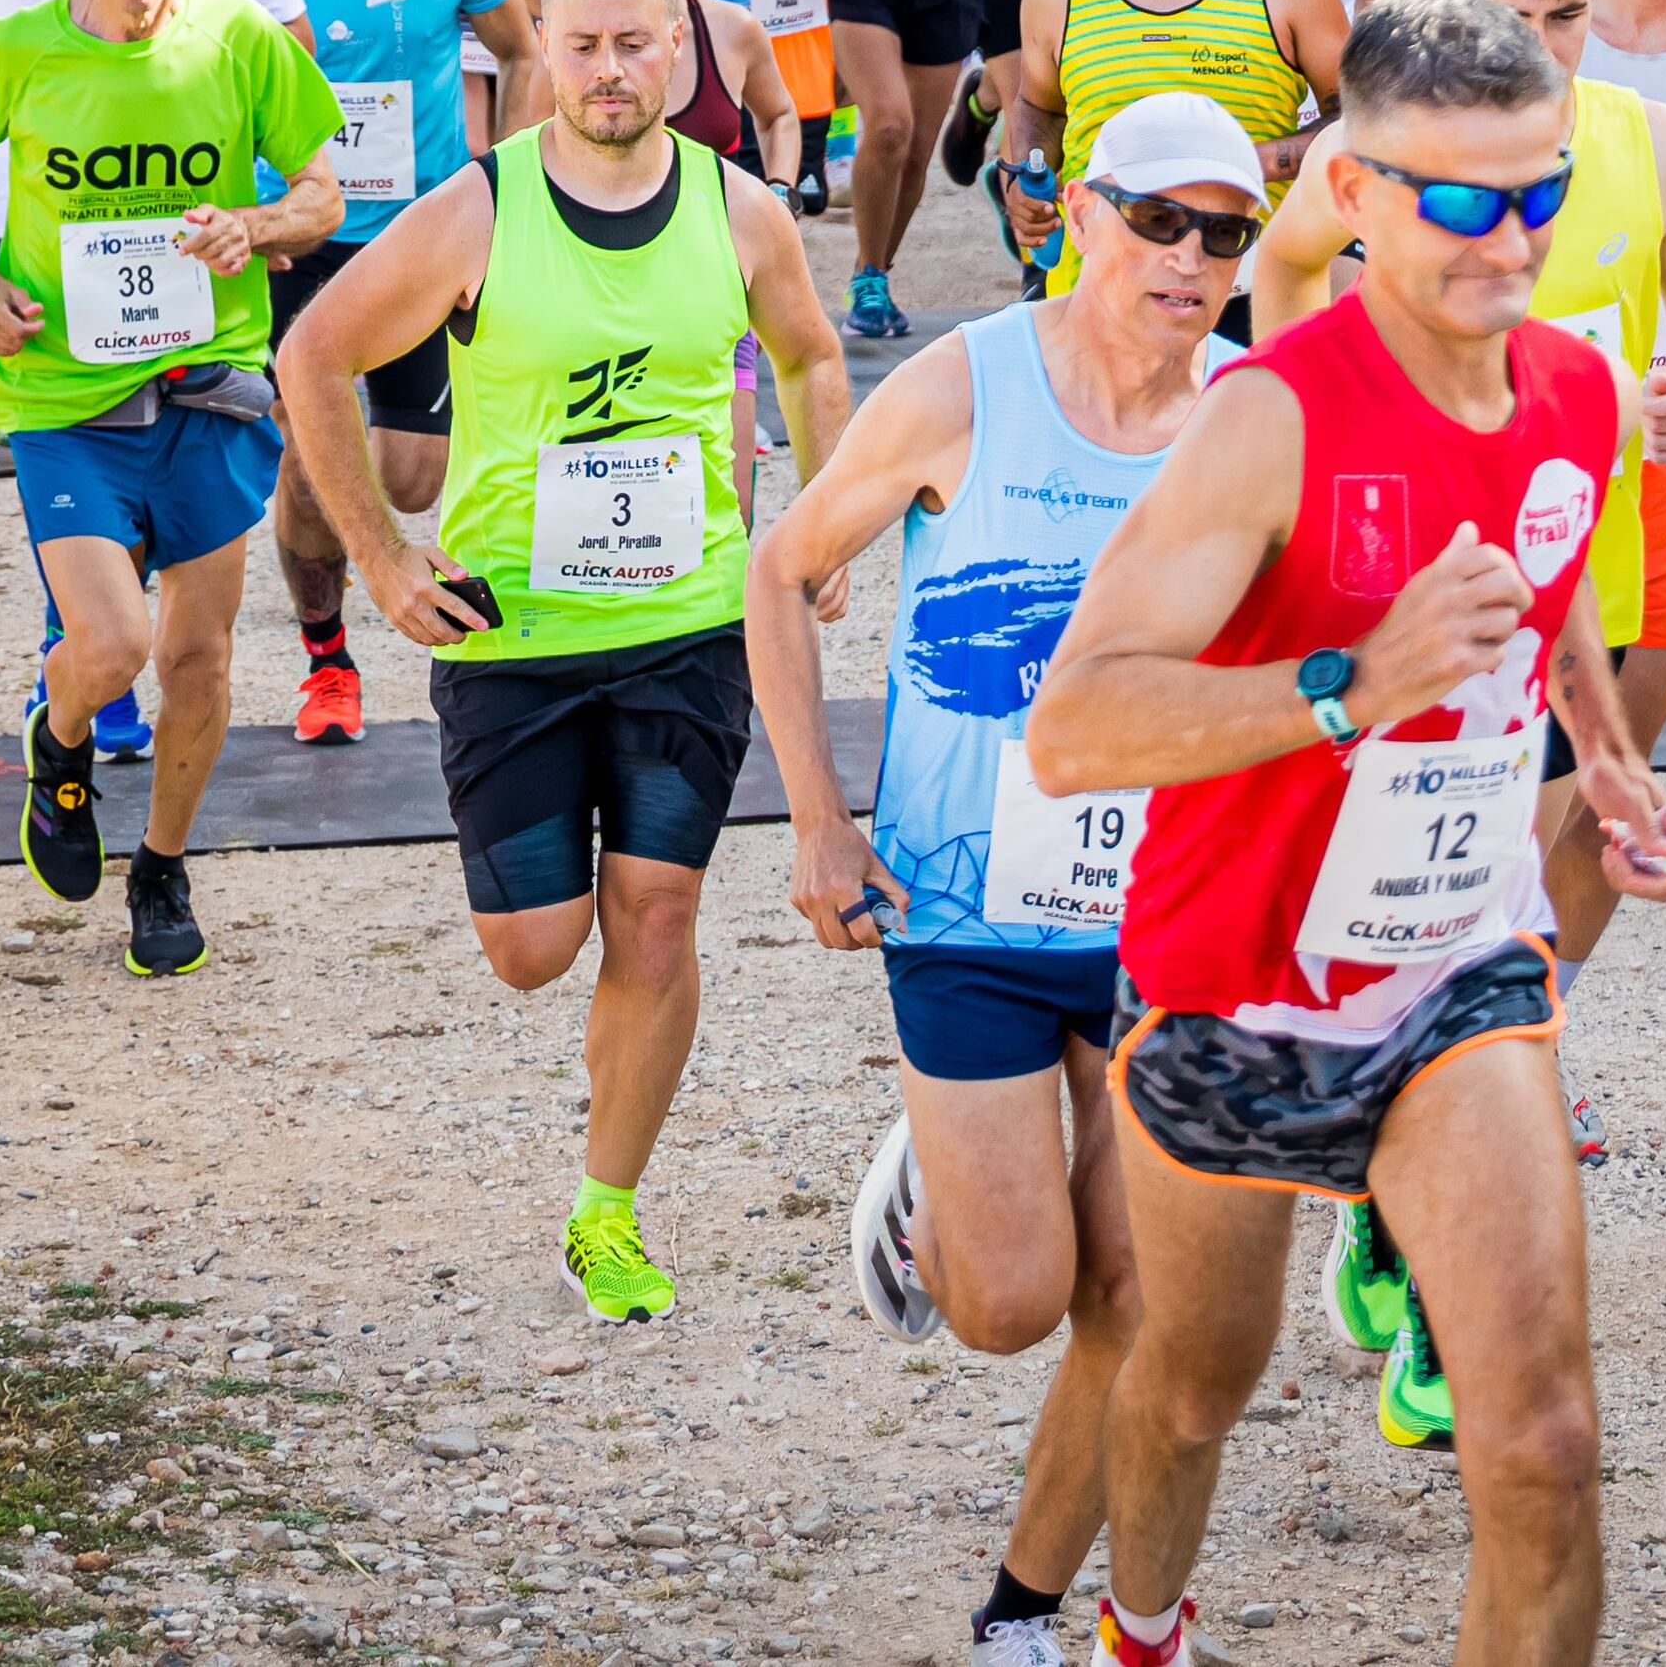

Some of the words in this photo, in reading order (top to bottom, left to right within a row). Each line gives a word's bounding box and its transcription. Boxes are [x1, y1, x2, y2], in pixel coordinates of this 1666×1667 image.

[1191, 65, 1250, 75] MENORCA
[333, 122, 365, 148] 47
[45, 141, 221, 191] sano
[59, 206, 109, 221] INFANTE
[100, 238, 122, 255] 10
[123, 234, 166, 246] MILLES
[118, 264, 155, 298] 38
[121, 304, 160, 324] Marin
[583, 459, 609, 479] 10
[611, 457, 659, 470] MILLES
[611, 492, 632, 527] 3
[1074, 491, 1129, 510] dream
[578, 534, 662, 554] Jordi_Piratilla
[1522, 517, 1569, 547] Trail
[1414, 767, 1446, 796] 10
[1448, 759, 1510, 781] MILLES
[1074, 806, 1125, 850] 19
[1425, 810, 1478, 863] 12
[1070, 861, 1118, 889] Pere
[1370, 875, 1430, 897] ANDREA
[1433, 873, 1444, 894] Y
[1445, 864, 1492, 892] MARTA
